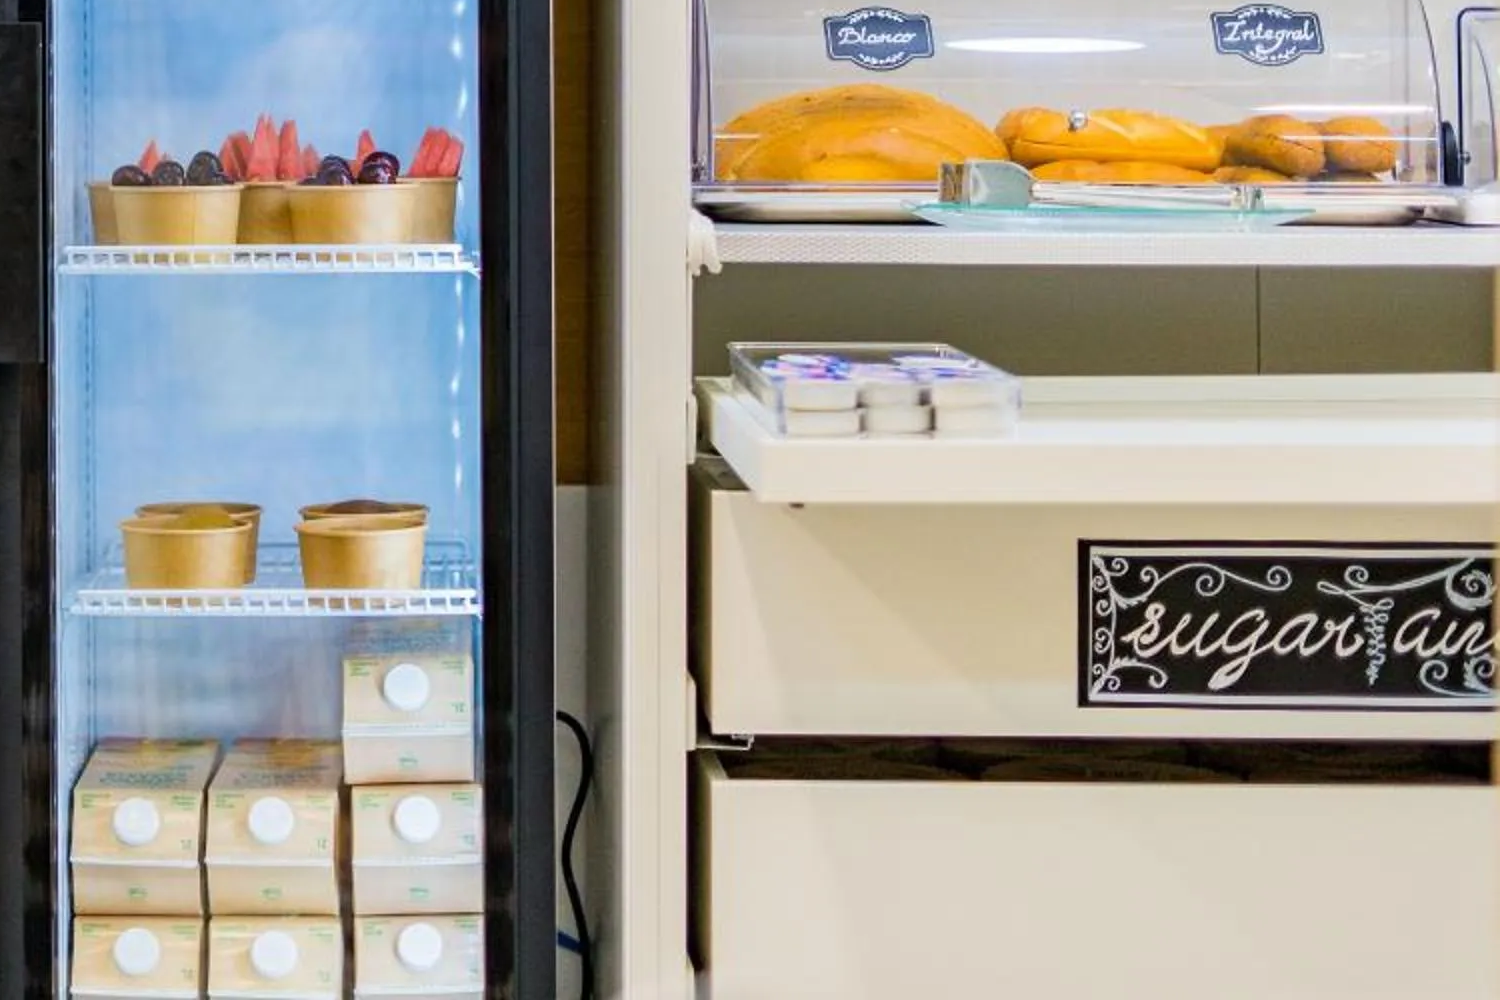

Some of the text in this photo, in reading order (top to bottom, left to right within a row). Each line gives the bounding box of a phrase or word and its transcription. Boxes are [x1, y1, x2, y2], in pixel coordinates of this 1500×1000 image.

[837, 27, 917, 45] Blanco
[1223, 19, 1315, 53] Integral
[1120, 602, 1366, 691] sugar
